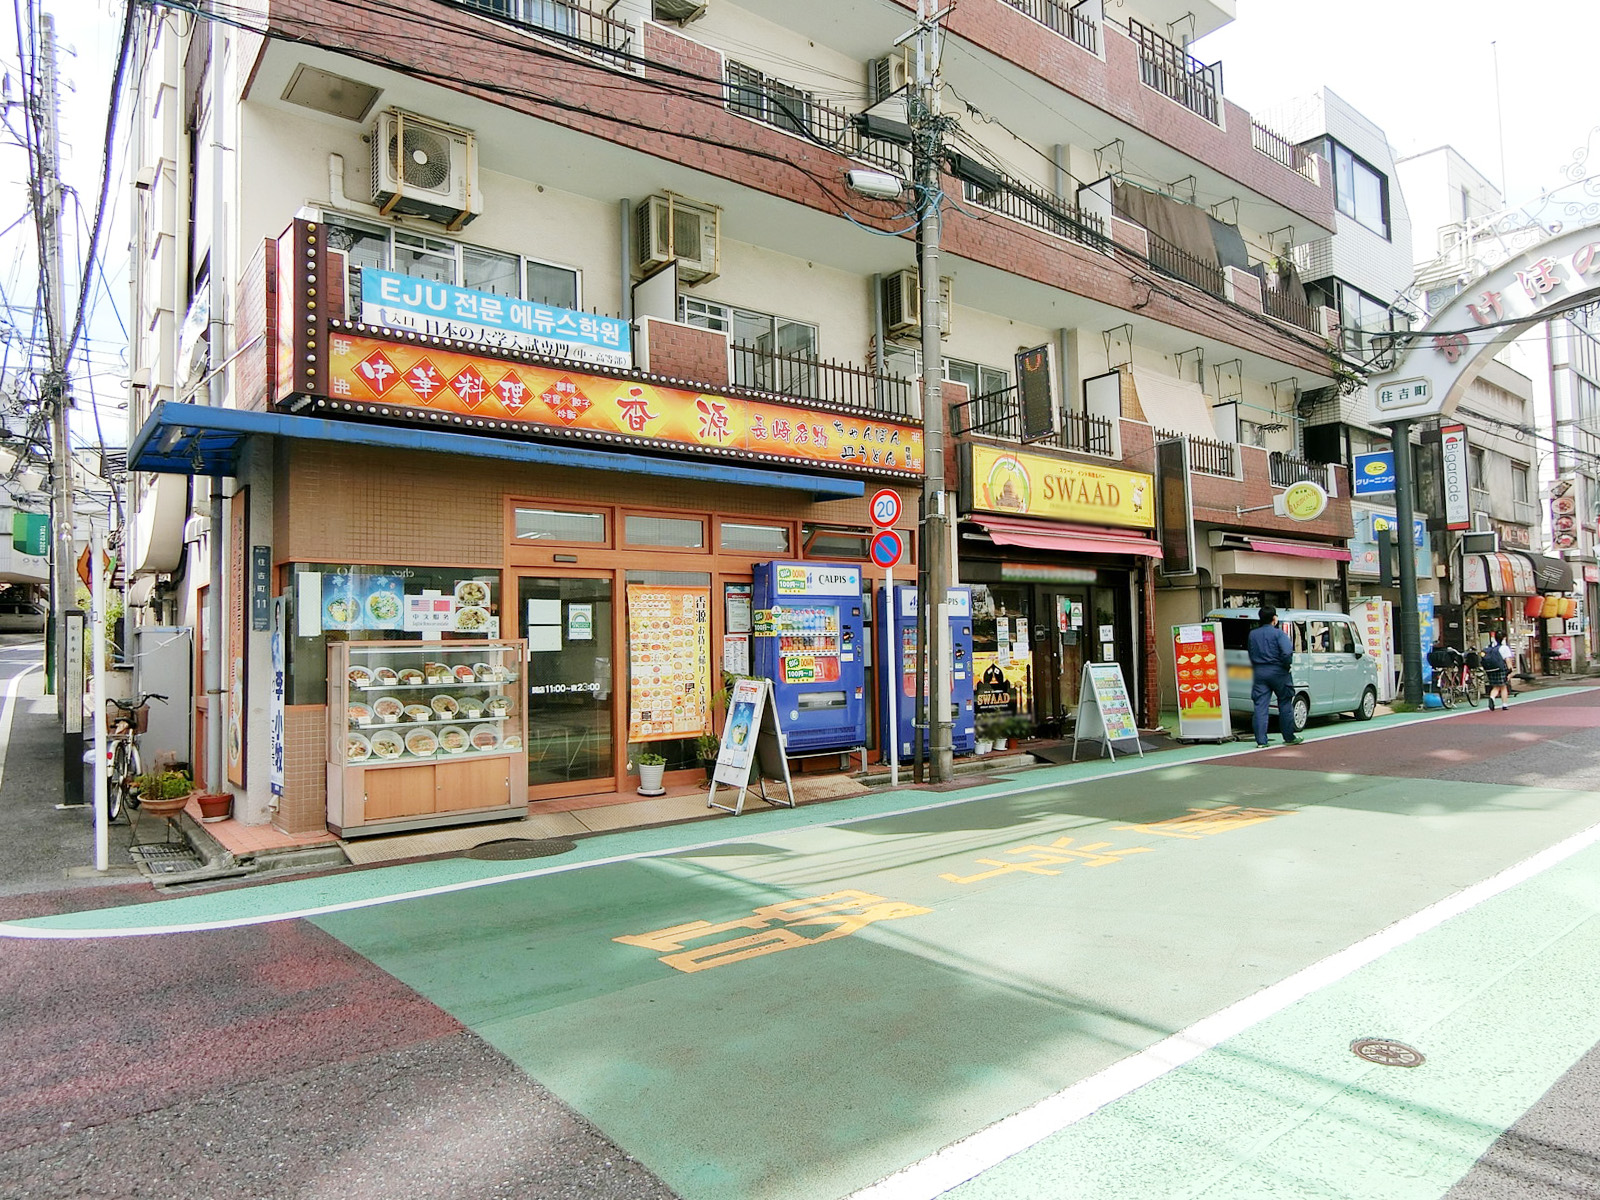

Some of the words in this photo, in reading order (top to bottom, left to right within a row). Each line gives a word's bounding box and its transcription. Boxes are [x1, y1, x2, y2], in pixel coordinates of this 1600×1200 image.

[380, 277, 447, 311] EJU
[454, 292, 504, 322] 전문
[510, 305, 619, 346] 에듀스학원
[391, 312, 414, 326] 入口
[425, 319, 570, 358] 日本の大学入試専門
[361, 359, 527, 408] 中華料理
[1381, 385, 1427, 404] 住吉町
[616, 386, 733, 443] 香源
[750, 414, 830, 448] 長崎名物
[832, 419, 901, 446] ちゃんぽん
[840, 445, 896, 466] 皿うどん
[1356, 475, 1395, 486] クリーニング
[1445, 443, 1461, 502] Bigarade
[1043, 475, 1120, 507] SWAAD
[876, 500, 895, 518] 20
[257, 558, 266, 593] 住吉町
[780, 568, 791, 578] BIG
[819, 574, 846, 585] CALPIS
[256, 600, 267, 608] 11
[787, 658, 799, 667] BIG
[801, 658, 814, 667] DOWN
[977, 692, 1010, 706] SWAAD
[611, 805, 1299, 973] 通学路
